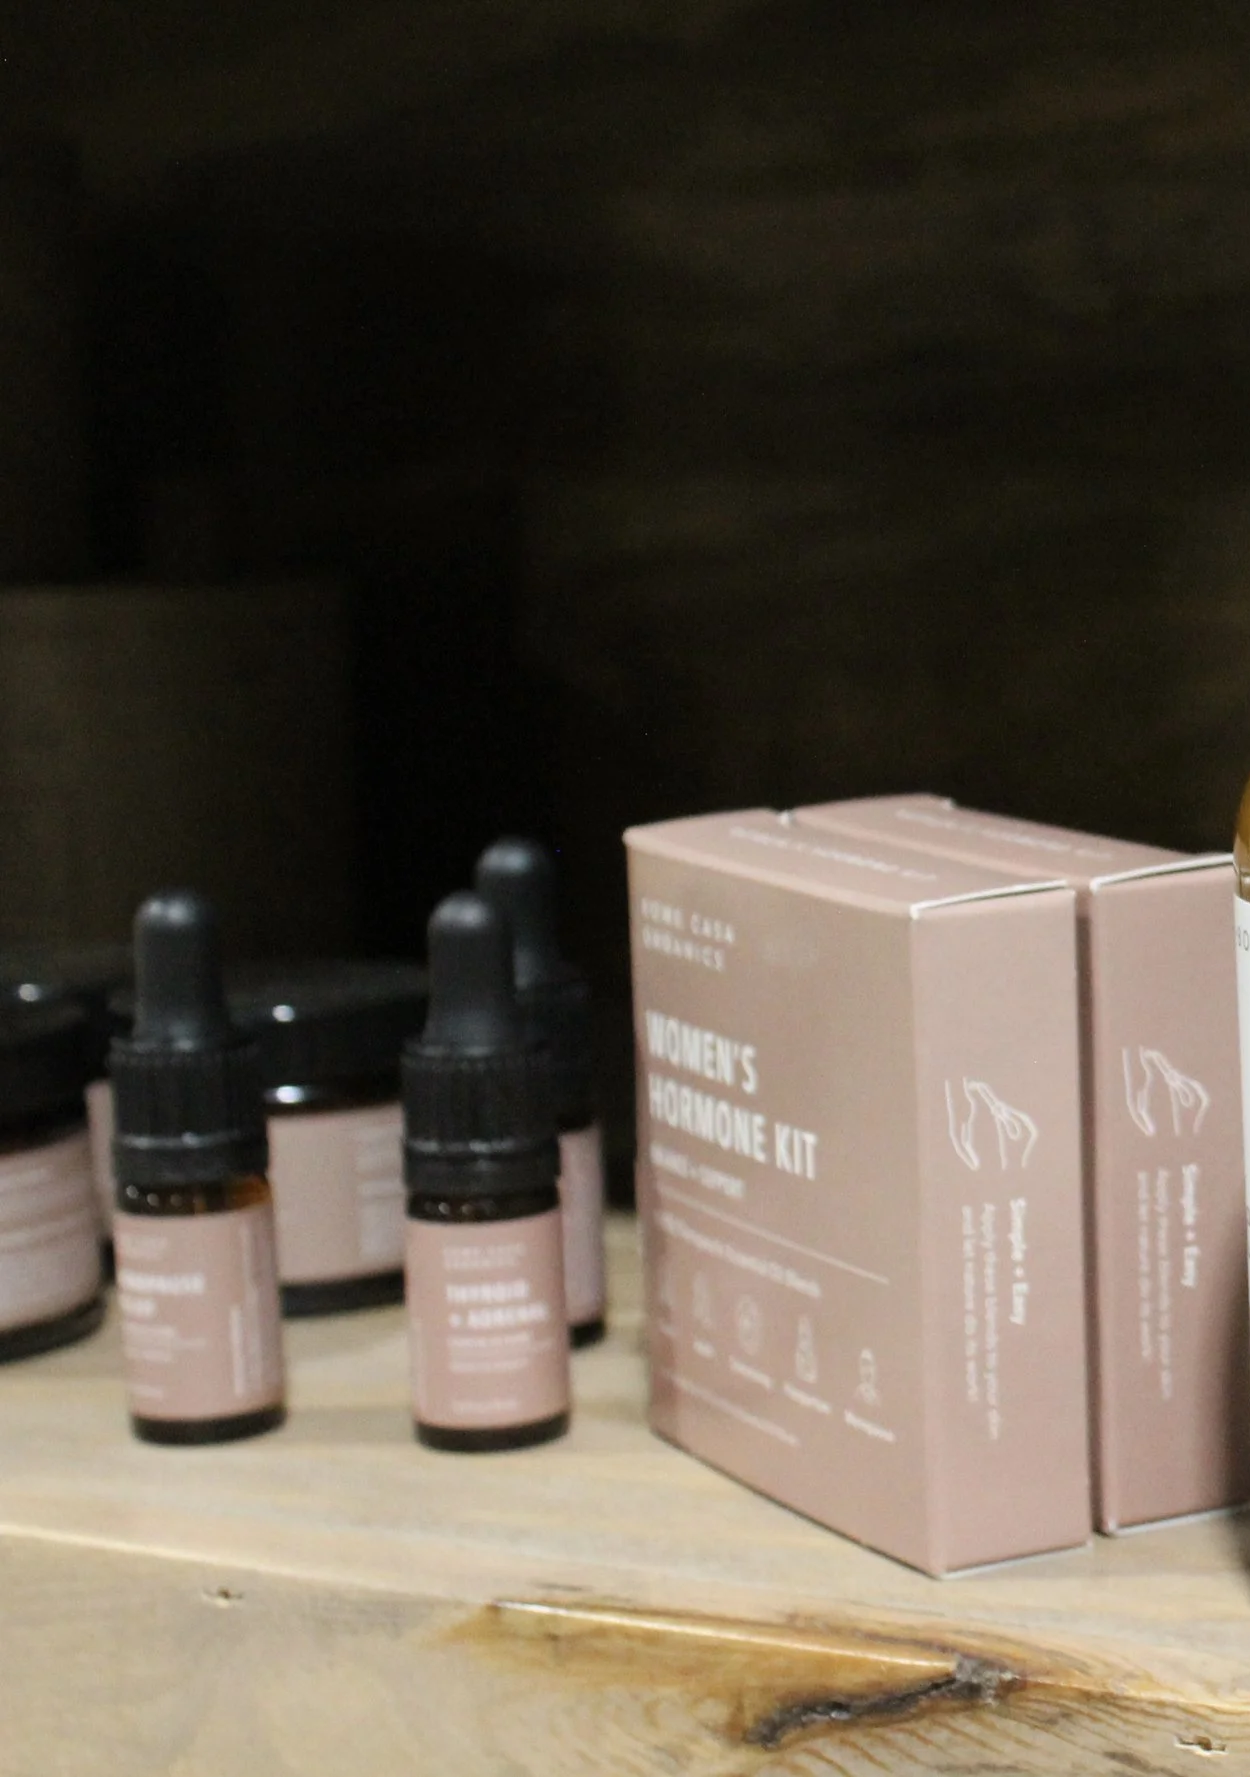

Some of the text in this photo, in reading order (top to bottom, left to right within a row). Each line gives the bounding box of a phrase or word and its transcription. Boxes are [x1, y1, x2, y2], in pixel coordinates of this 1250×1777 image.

[646, 1009, 758, 1095] WOMEN'S
[648, 1072, 818, 1181] HORMONE KIT
